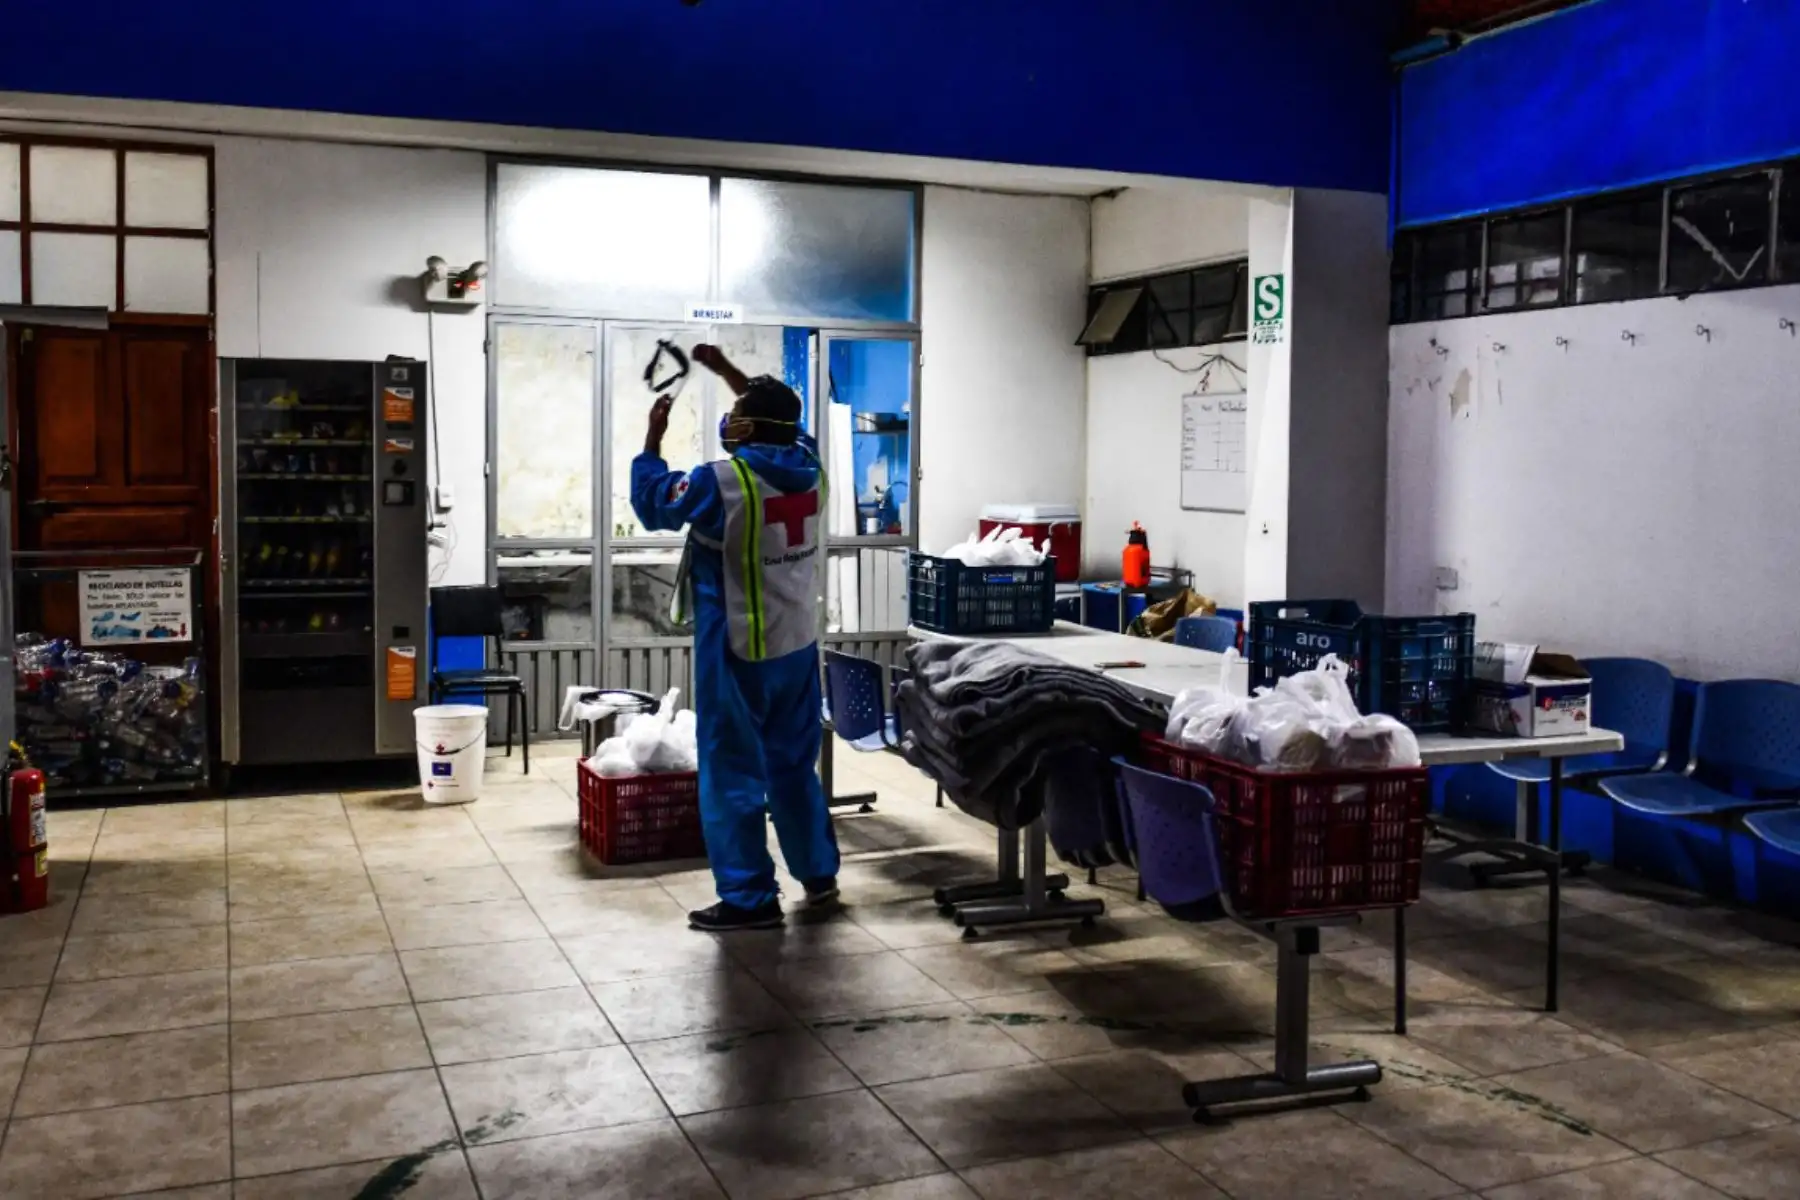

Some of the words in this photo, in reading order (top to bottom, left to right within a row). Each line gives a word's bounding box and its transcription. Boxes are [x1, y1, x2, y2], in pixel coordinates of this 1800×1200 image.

[1257, 276, 1281, 319] S
[692, 309, 733, 319] BIENESTAR
[133, 581, 143, 589] DE
[146, 580, 183, 588] BOTELLAS
[1296, 632, 1331, 649] aro
